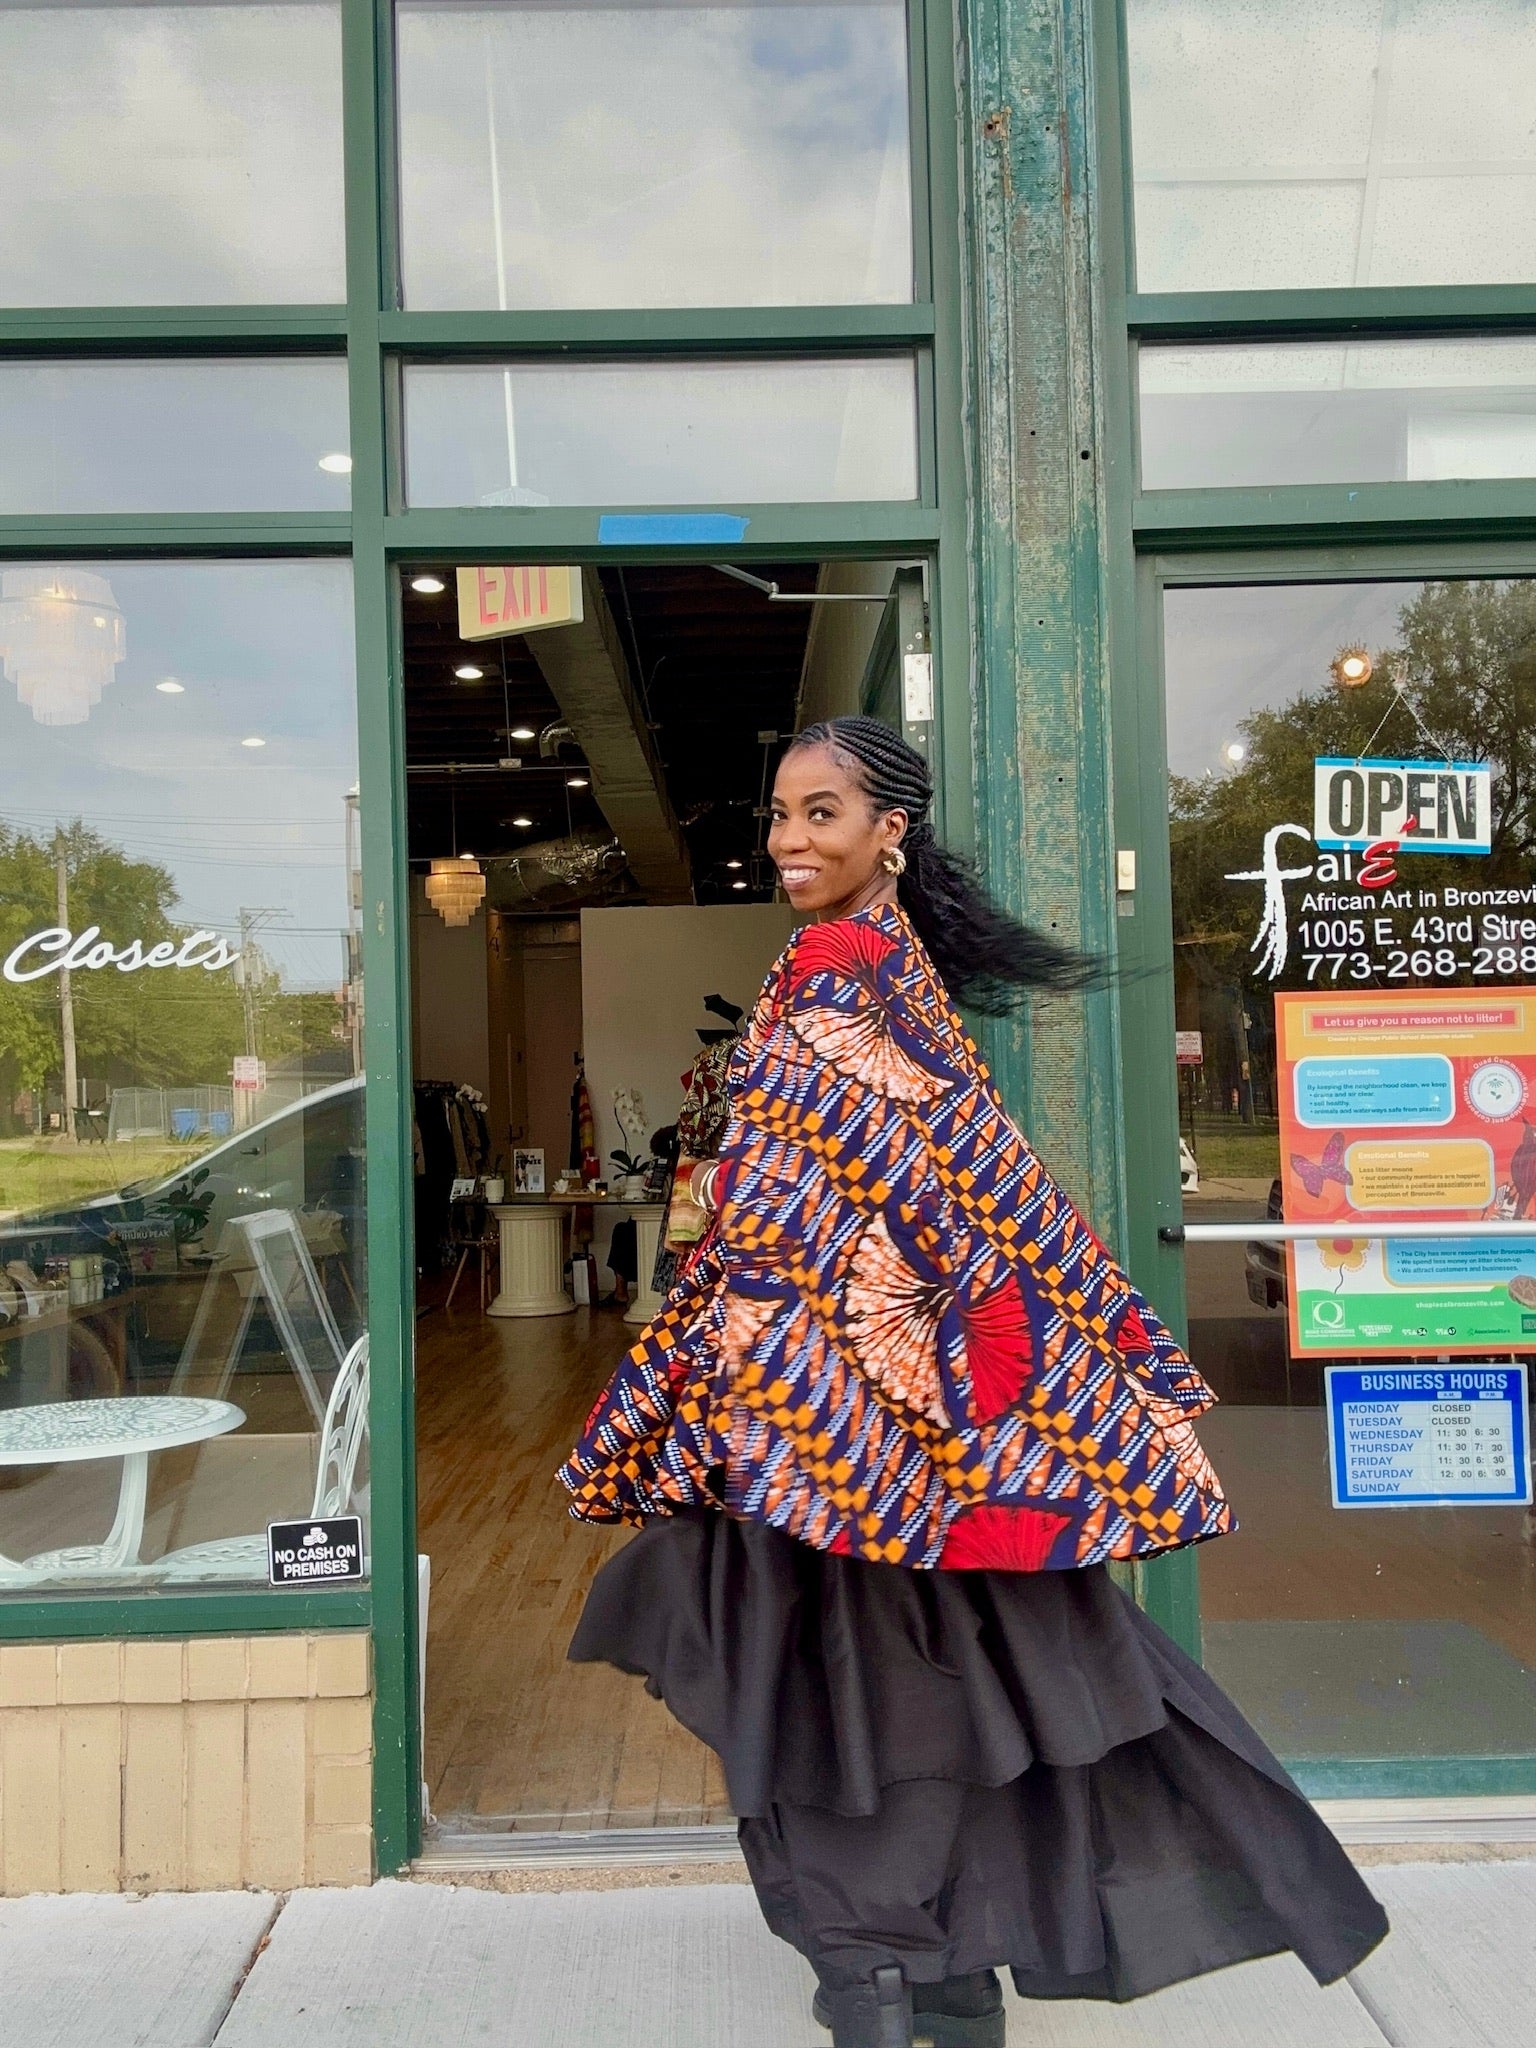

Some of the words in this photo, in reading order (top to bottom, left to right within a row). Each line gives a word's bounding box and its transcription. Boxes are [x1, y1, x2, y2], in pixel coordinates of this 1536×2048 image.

[1328, 769, 1477, 839] OPEN
[1301, 892, 1376, 912] African
[1381, 890, 1413, 909] Art
[1419, 887, 1436, 907] in
[1299, 920, 1365, 948] 1005
[1375, 919, 1401, 944] E.
[1411, 915, 1472, 944] 43rd
[1483, 914, 1536, 942] Stre
[3, 926, 241, 982] Closets
[1302, 947, 1536, 981] 773-268-288
[1324, 1018, 1340, 1026] Let
[1357, 1017, 1378, 1027] give
[1381, 1018, 1398, 1027] you
[1410, 1016, 1444, 1024] reason
[1447, 1015, 1462, 1023] not
[1464, 1015, 1474, 1023] to
[1476, 1014, 1503, 1023] litter!
[1472, 1057, 1492, 1069] Quad
[1313, 1301, 1344, 1328] Q
[1361, 1374, 1445, 1391] BUSINESS
[1450, 1374, 1508, 1390] HOURS
[1348, 1404, 1400, 1414] MONDAY
[1432, 1404, 1471, 1412] CLOSED
[1349, 1417, 1403, 1427] TUESDAY
[1431, 1417, 1471, 1425] CLOSED
[1350, 1430, 1423, 1440] WEDNESDAY
[1437, 1429, 1451, 1437] 11:
[1455, 1429, 1467, 1437] 30
[1489, 1428, 1500, 1436] 30
[1350, 1443, 1414, 1453] THURSDAY
[1437, 1443, 1451, 1451] 11:
[1455, 1443, 1467, 1451] 30
[1491, 1444, 1503, 1452] 30
[1351, 1456, 1393, 1466] FRIDAY
[1439, 1457, 1452, 1465] 11:
[1459, 1456, 1470, 1465] 30
[1476, 1456, 1484, 1464] 6:
[1493, 1456, 1505, 1464] 30
[1352, 1469, 1414, 1479] SATURDAY
[1440, 1470, 1454, 1478] 12:
[1461, 1470, 1472, 1478] 00
[1495, 1468, 1506, 1477] 30
[1353, 1483, 1401, 1493] SUNDAY
[275, 1549, 296, 1564] NO
[297, 1546, 335, 1562] CASH
[336, 1544, 356, 1560] ON
[283, 1559, 350, 1579] PREMISES
